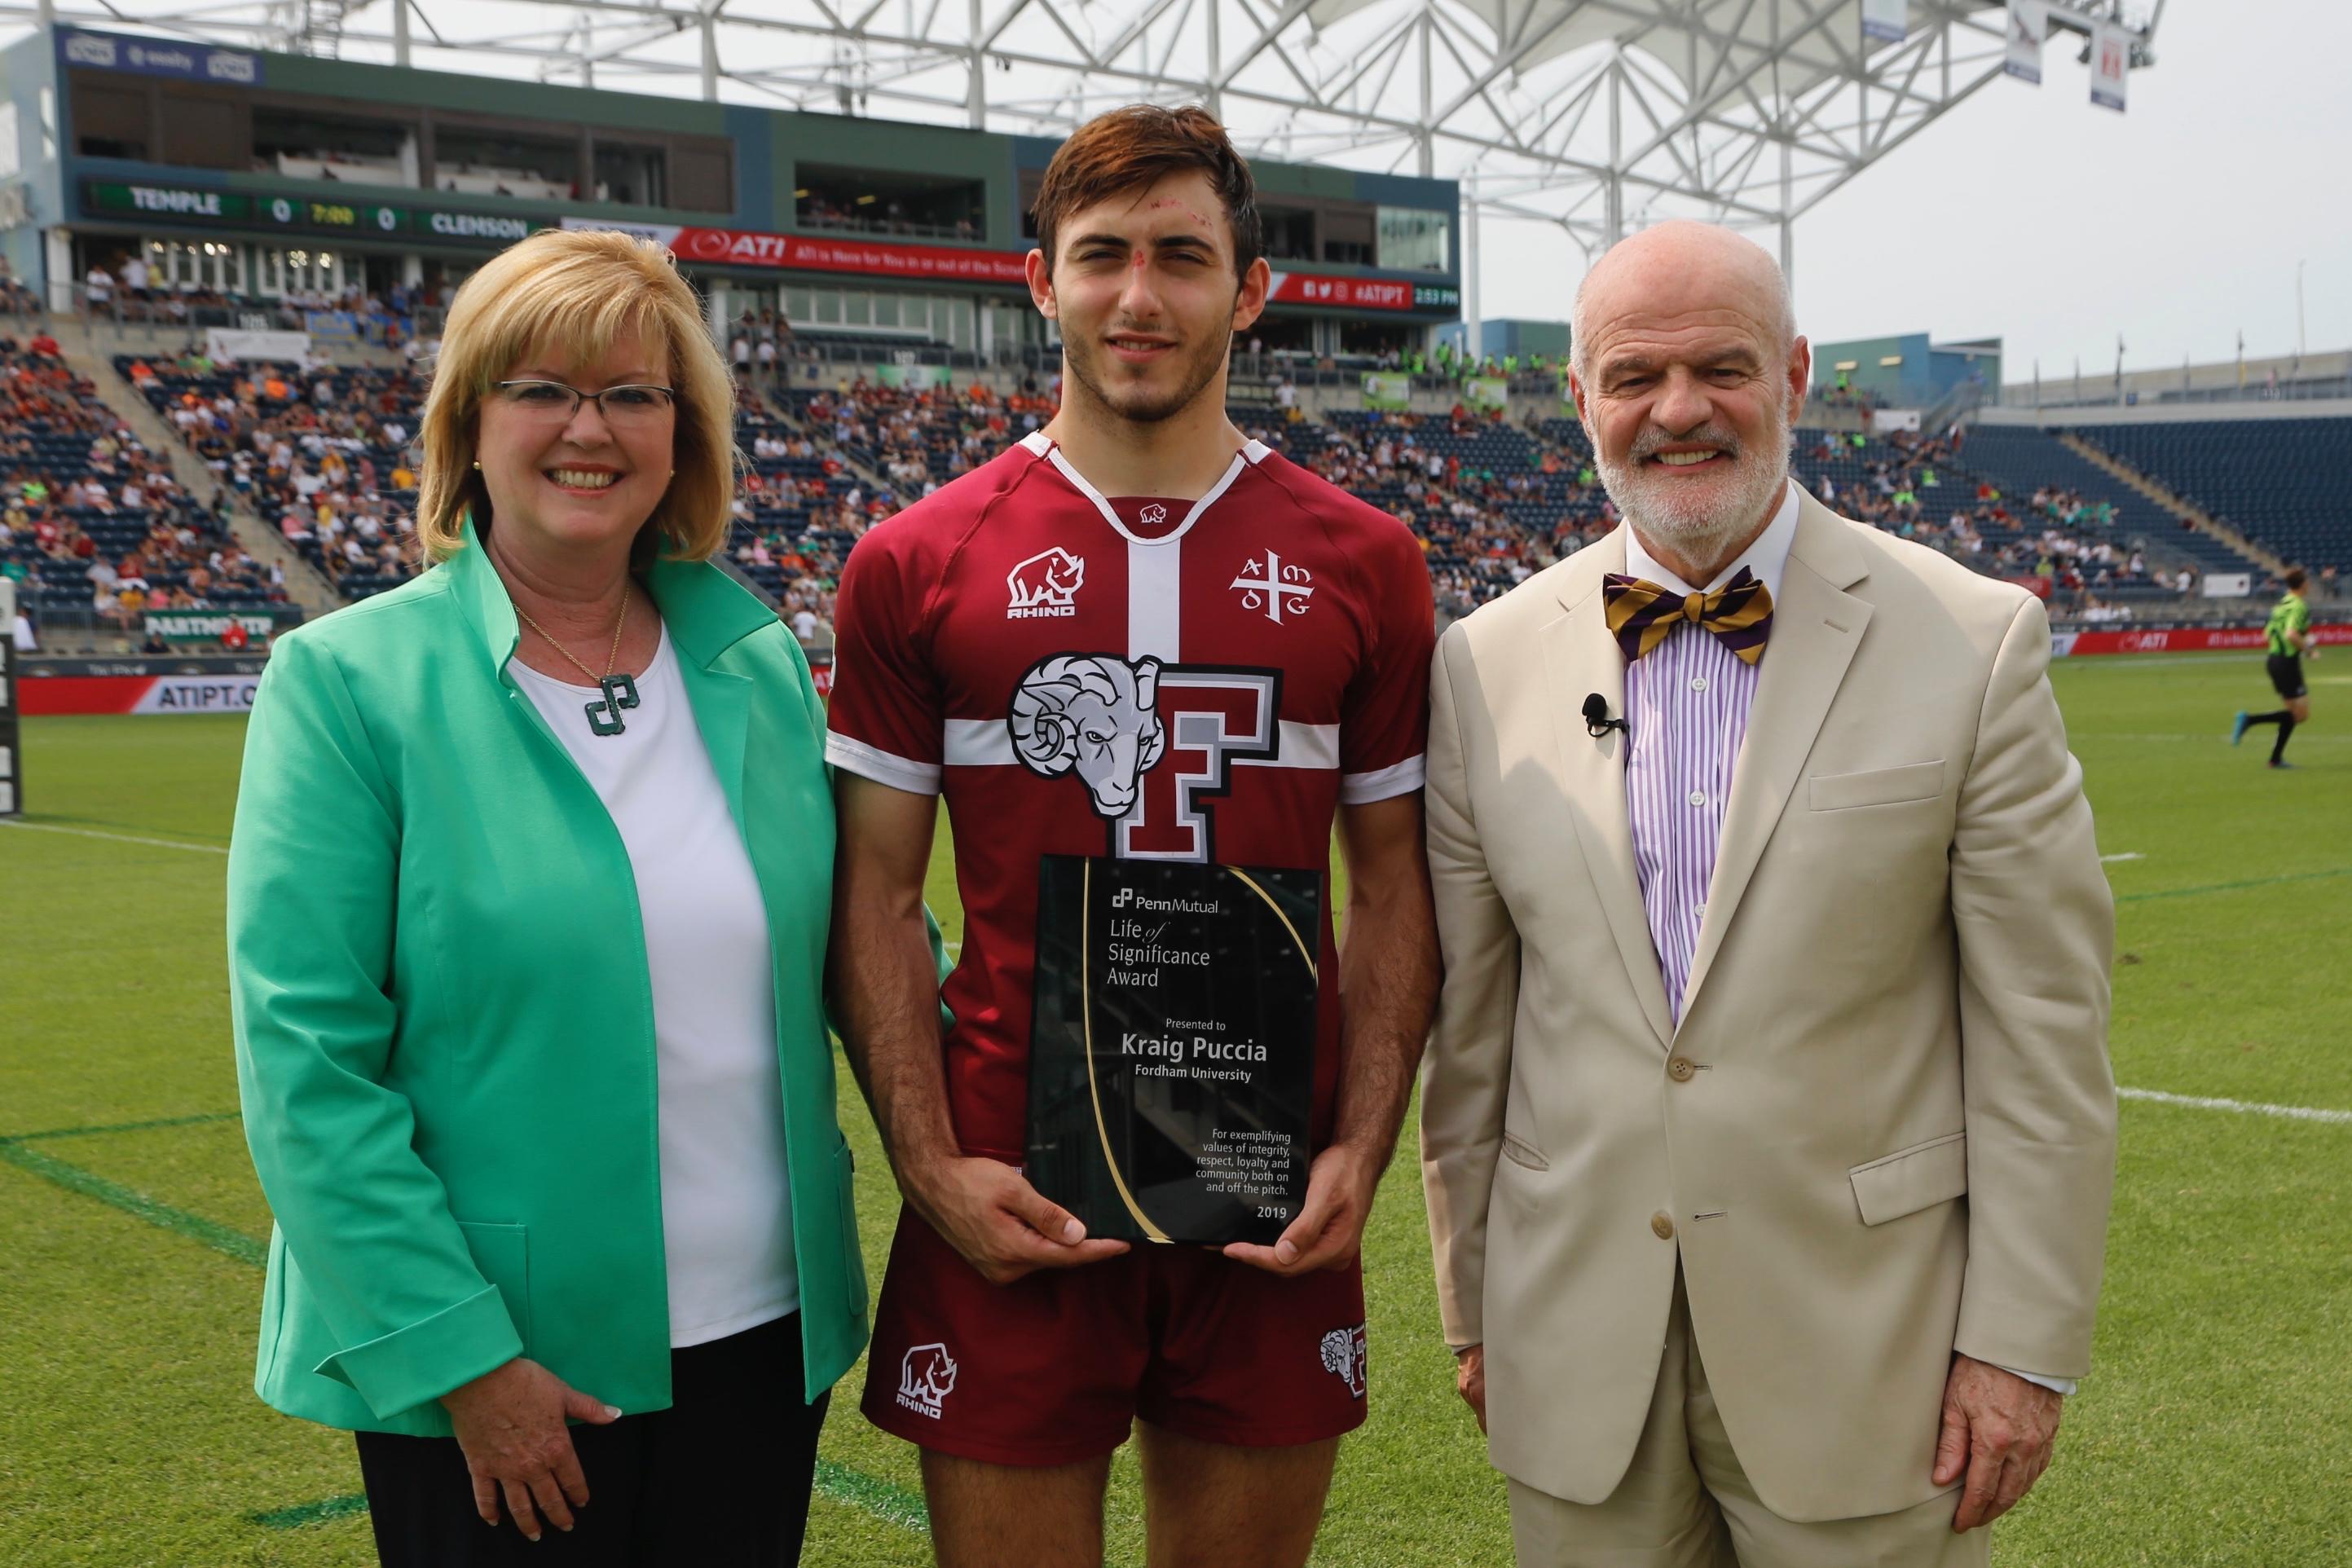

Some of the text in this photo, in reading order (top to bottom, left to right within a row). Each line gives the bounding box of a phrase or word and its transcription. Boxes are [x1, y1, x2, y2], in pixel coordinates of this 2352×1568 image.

[129, 186, 221, 216] TEMPLE
[271, 198, 291, 222] 0
[377, 207, 396, 231] 0
[431, 213, 528, 239] CLEMSON
[729, 234, 786, 258] ATI
[1354, 284, 1405, 304] #ATIPT
[1006, 606, 1076, 619] RHINO
[157, 684, 257, 707] ATIPT.C
[1136, 896, 1218, 914] PennMutual
[1110, 918, 1171, 944] Life of
[1108, 943, 1210, 966] Significance
[1107, 967, 1159, 987] Award
[1165, 1018, 1227, 1031] Presented to
[1121, 1033, 1267, 1063] Kraig Puccia
[1134, 1064, 1252, 1084] Fordham University
[1212, 1129, 1291, 1145] For exemplifying
[1203, 1141, 1290, 1158] values of integrity,
[1196, 1156, 1290, 1170] respect, loyalty and
[1196, 1169, 1288, 1183] community both on
[1206, 1182, 1288, 1196] and off the pitch.
[1257, 1206, 1287, 1219] 2019
[896, 1393, 942, 1420] RHINO
